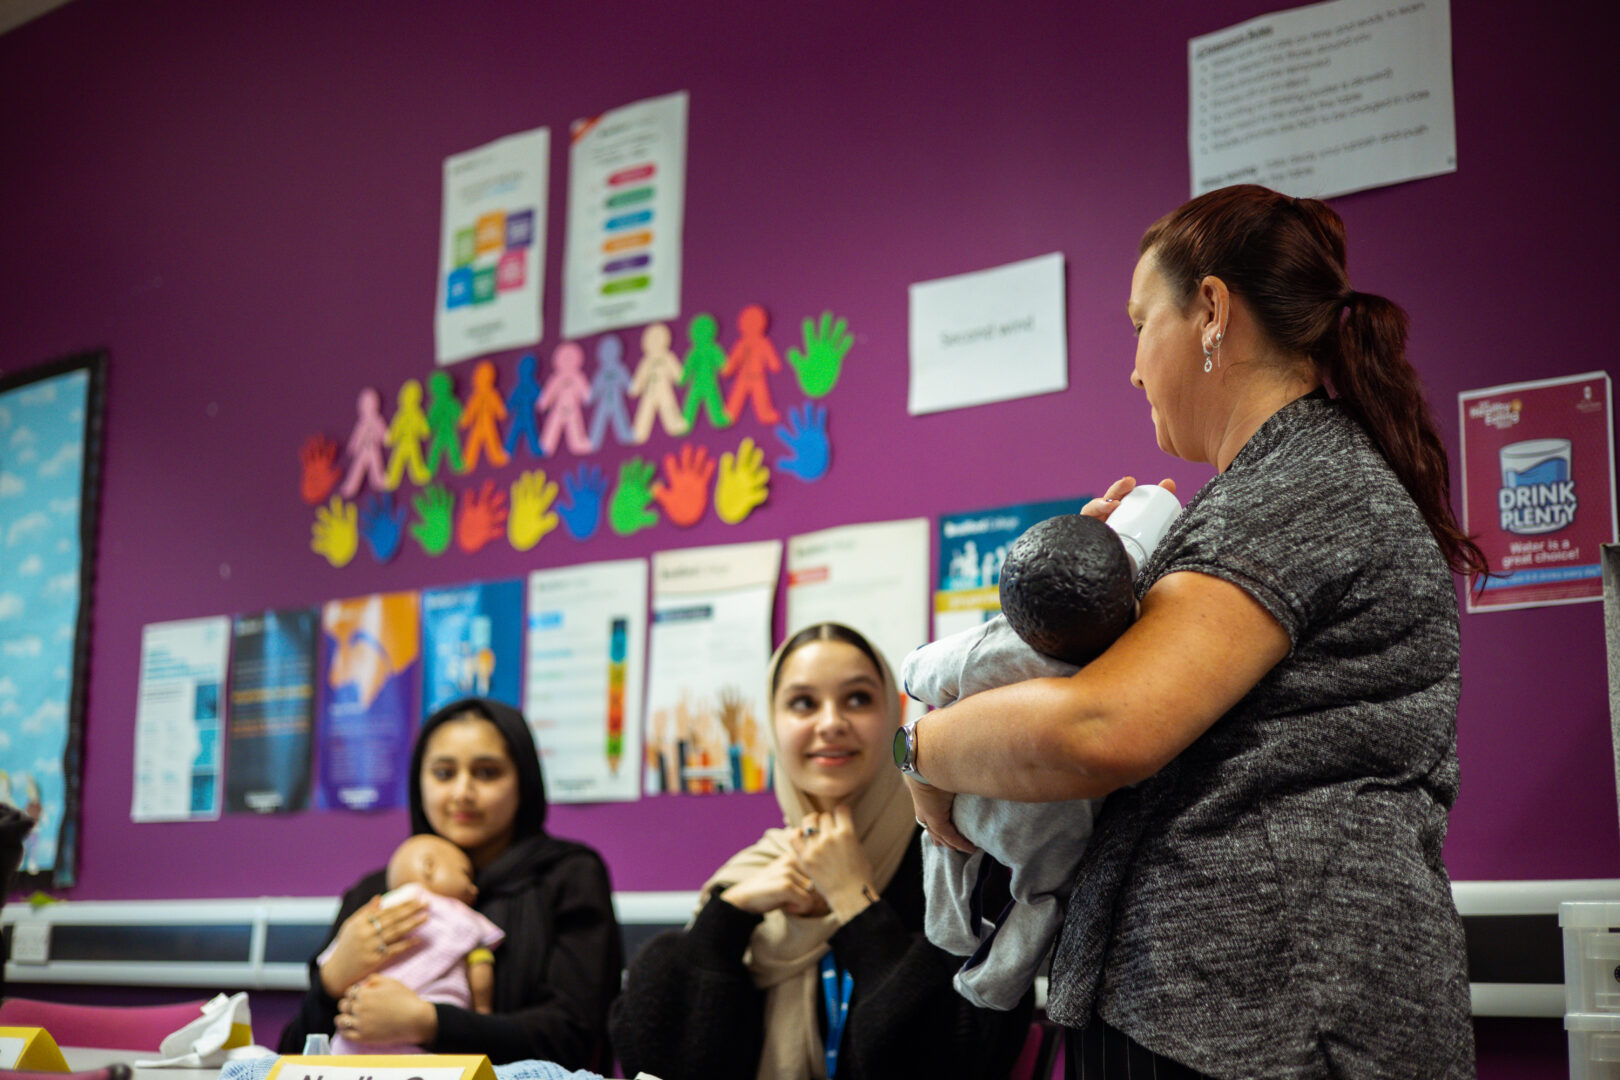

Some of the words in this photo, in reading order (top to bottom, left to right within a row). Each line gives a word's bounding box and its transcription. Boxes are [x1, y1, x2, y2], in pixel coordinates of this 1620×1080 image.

[1499, 481, 1577, 510] DRINK
[1501, 503, 1577, 530] PLENTY
[1502, 551, 1533, 569] great
[1535, 547, 1580, 564] choice!
[1510, 541, 1545, 555] Water
[1548, 539, 1559, 550] is
[1562, 539, 1570, 549] a
